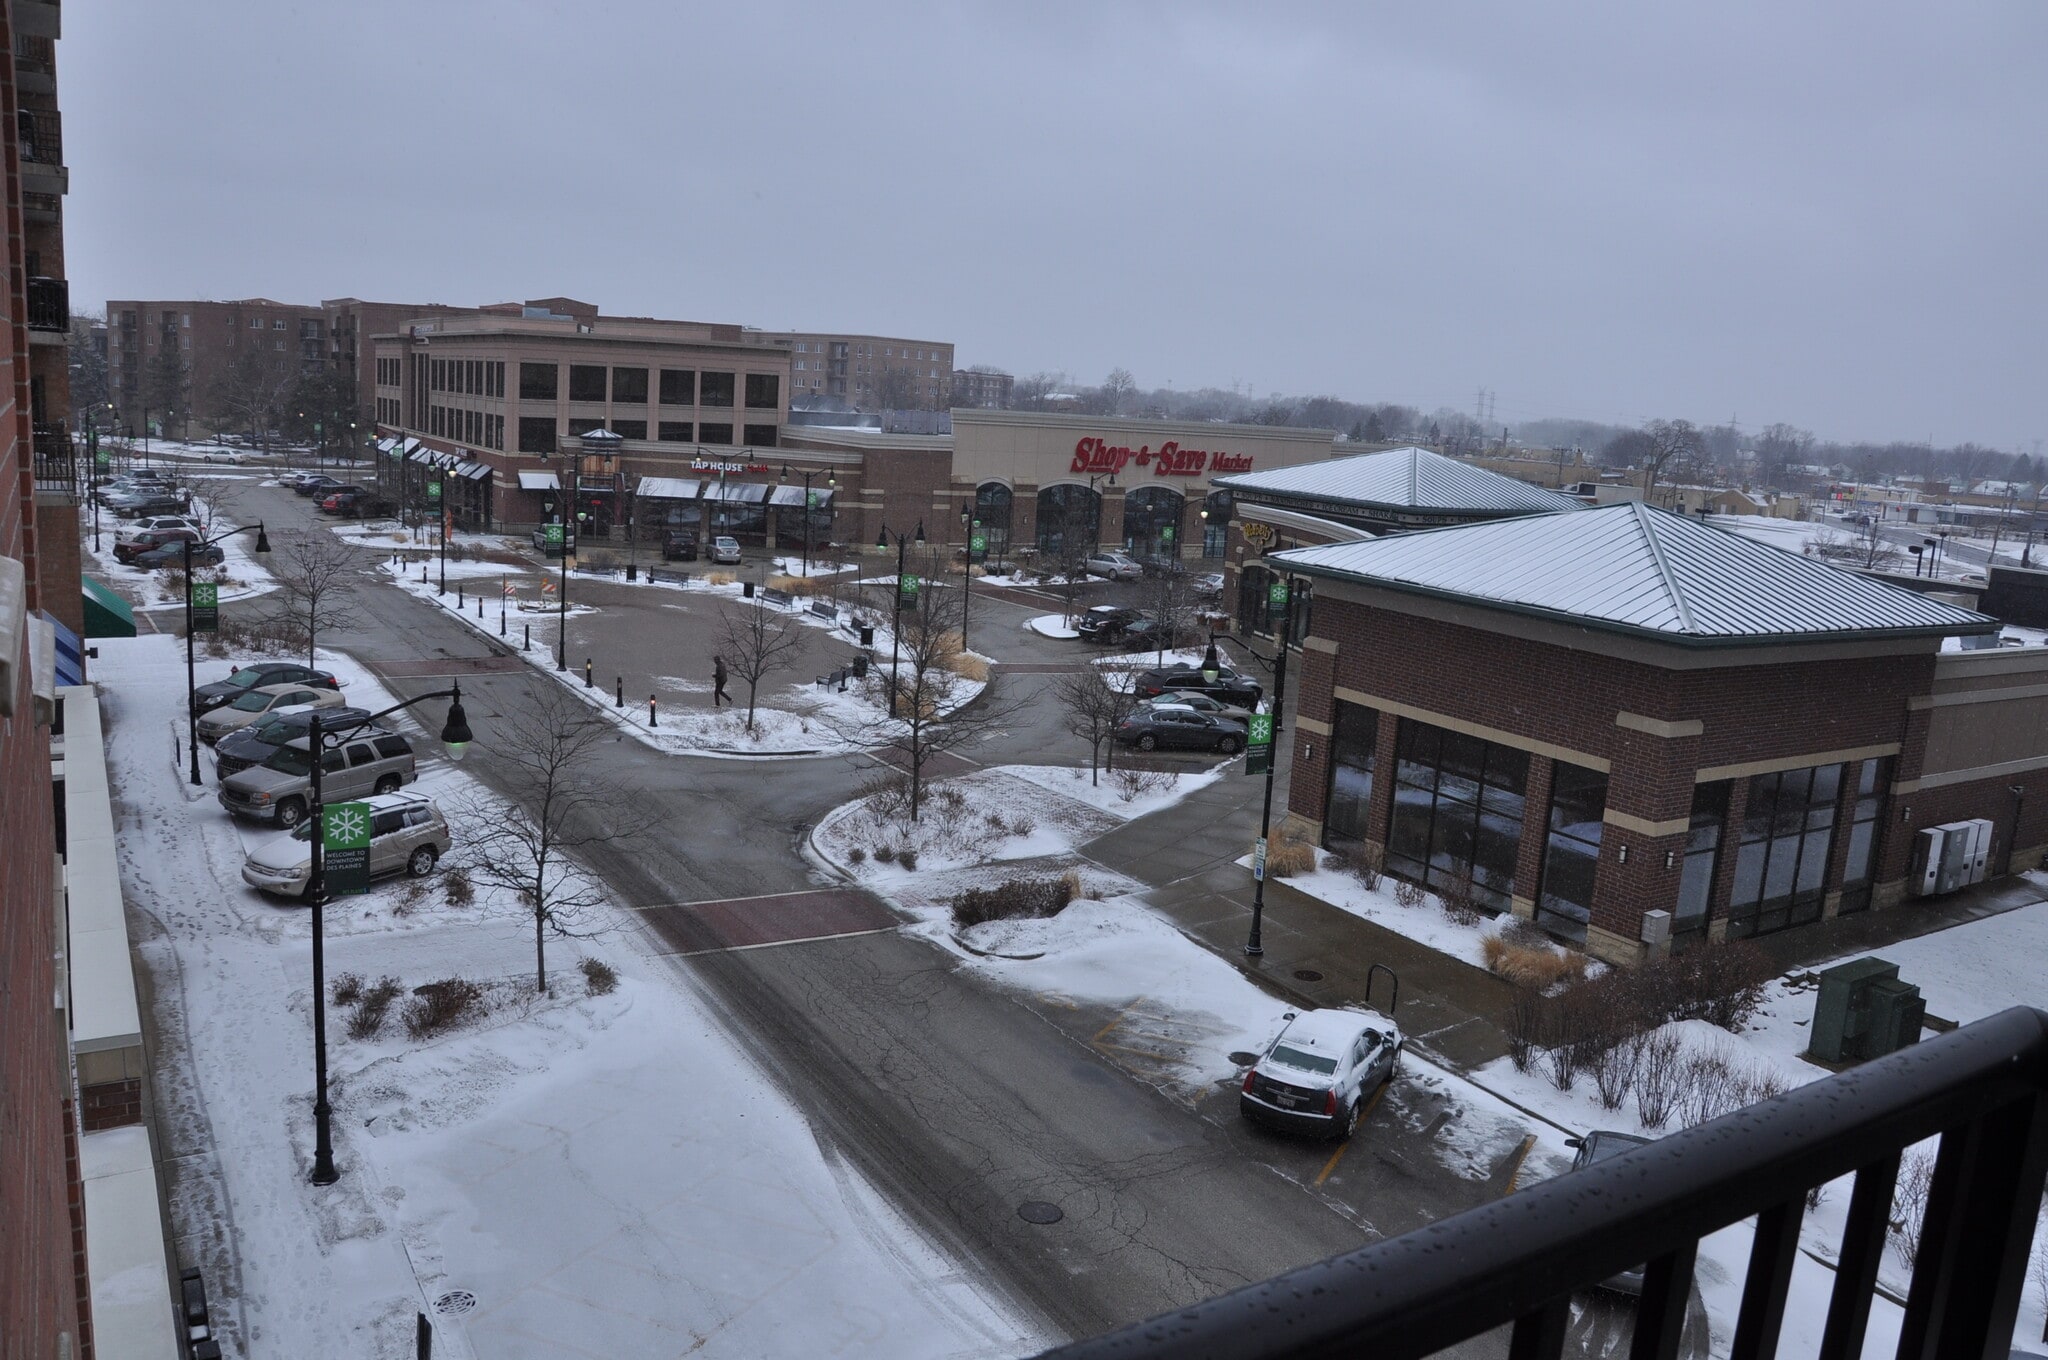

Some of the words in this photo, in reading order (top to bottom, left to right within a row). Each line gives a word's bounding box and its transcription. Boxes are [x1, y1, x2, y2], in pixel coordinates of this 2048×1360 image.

[690, 461, 709, 470] TAP
[710, 462, 743, 473] HOUSE
[1208, 451, 1254, 473] Market
